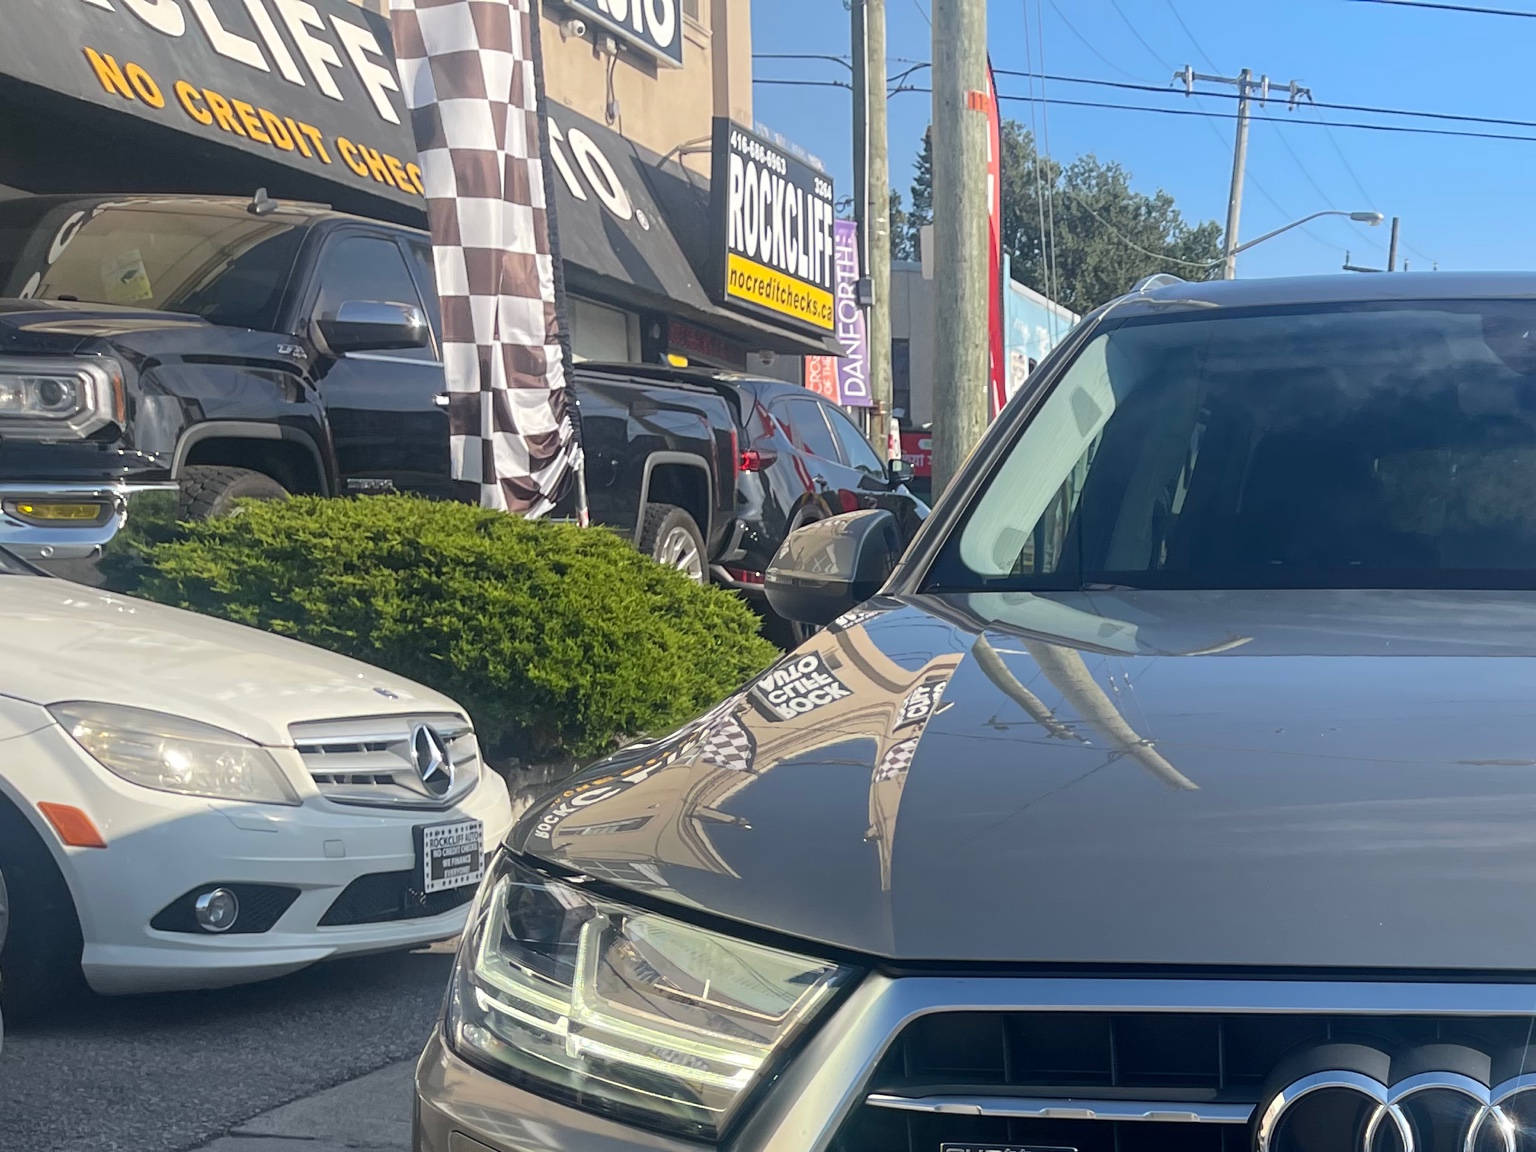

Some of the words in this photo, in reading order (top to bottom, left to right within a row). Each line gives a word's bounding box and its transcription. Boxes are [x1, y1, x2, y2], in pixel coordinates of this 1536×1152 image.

[83, 46, 165, 109] NO
[173, 80, 332, 165] CREDIT
[730, 131, 786, 176] 416-686-6963
[729, 153, 832, 288] ROCKCLIFF
[729, 267, 832, 321] nocreditchecks.ca
[837, 246, 867, 396] DANFORTH
[430, 834, 464, 848] ROCKCLIFF
